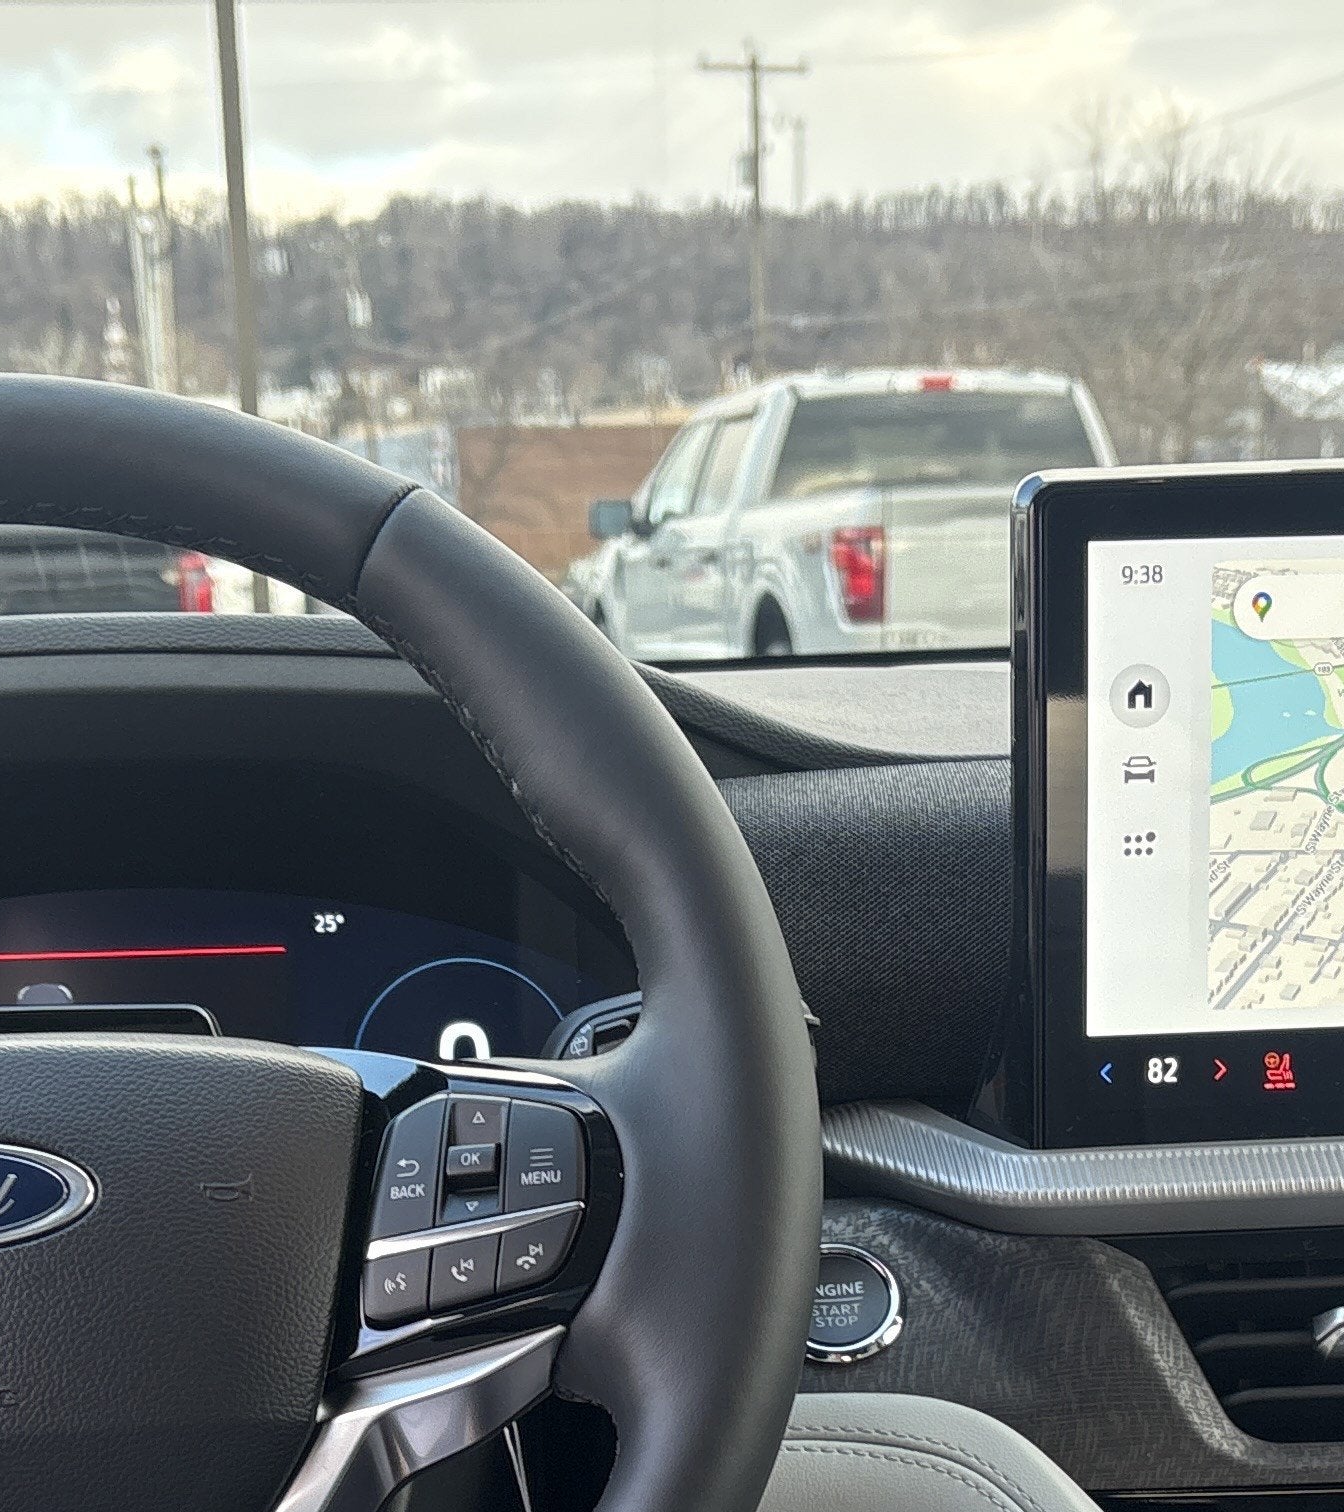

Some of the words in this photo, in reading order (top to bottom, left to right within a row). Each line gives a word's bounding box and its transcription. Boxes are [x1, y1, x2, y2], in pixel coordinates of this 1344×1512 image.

[1121, 564, 1164, 585] 9:38
[1310, 805, 1335, 844] Wayne
[1328, 790, 1342, 805] St
[1217, 861, 1231, 873] St
[1297, 905, 1307, 916] S
[1304, 875, 1332, 909] Wayne
[1331, 860, 1344, 876] St
[313, 913, 345, 934] 25°
[1146, 1058, 1179, 1082] 82
[460, 1151, 481, 1166] OK
[520, 1169, 562, 1187] MENU
[389, 1182, 426, 1200] BACK
[815, 1281, 865, 1297] NGINE
[812, 1303, 861, 1317] START
[816, 1315, 859, 1328] STOP
